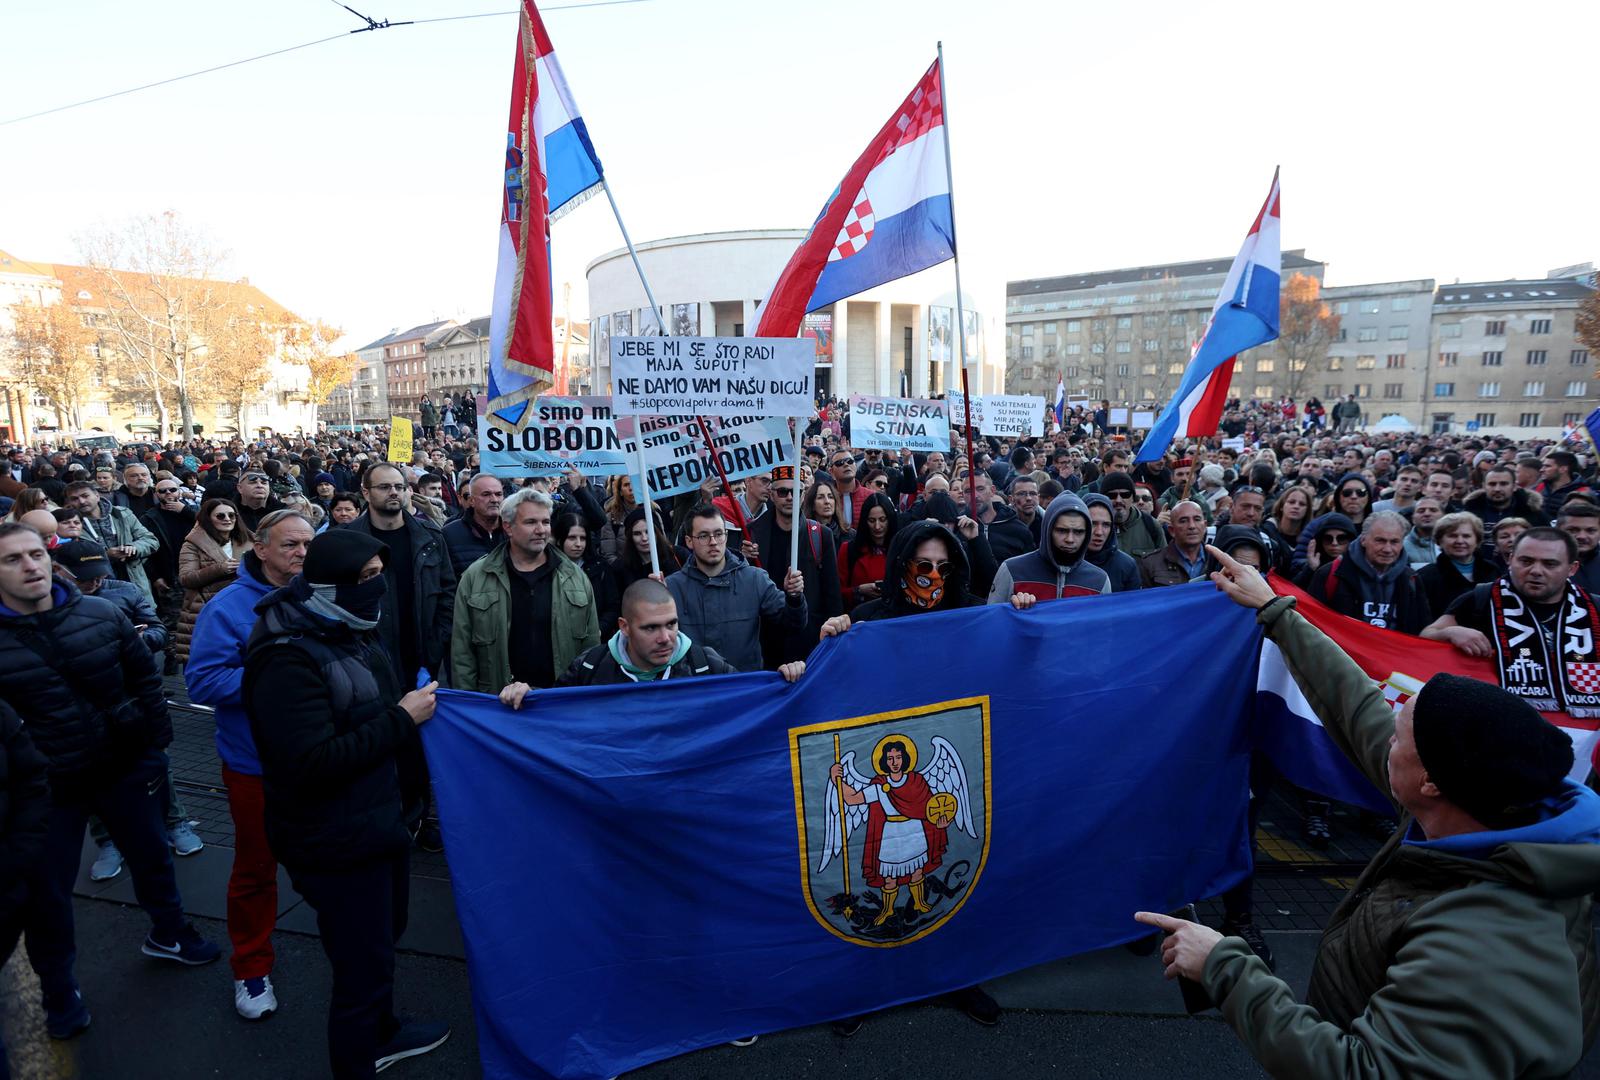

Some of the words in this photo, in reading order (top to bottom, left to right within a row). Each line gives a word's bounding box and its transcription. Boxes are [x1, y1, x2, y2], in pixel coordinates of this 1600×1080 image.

[618, 341, 655, 357] JEBE
[663, 341, 680, 356] MI
[689, 342, 706, 357] SE
[715, 342, 740, 359] ŠTO
[744, 345, 775, 360] RADI
[647, 358, 683, 372] MAJA
[618, 378, 640, 395] NE
[645, 377, 688, 394] DAMO
[692, 378, 721, 393] VAM
[727, 376, 766, 395] NAŠU
[770, 376, 809, 395] DICU!
[539, 406, 584, 420] smo
[592, 406, 618, 420] m
[856, 398, 943, 419] ŠIBENSKA
[686, 420, 713, 438] QR
[874, 421, 927, 436] STINA
[673, 440, 697, 458] mi
[703, 432, 741, 450] smo
[905, 440, 934, 448] slobodni
[523, 460, 570, 469] ŠIBENSKA
[573, 460, 600, 469] STINA
[647, 438, 785, 493] NEPOKORIVI
[1507, 684, 1549, 696] OVČARA
